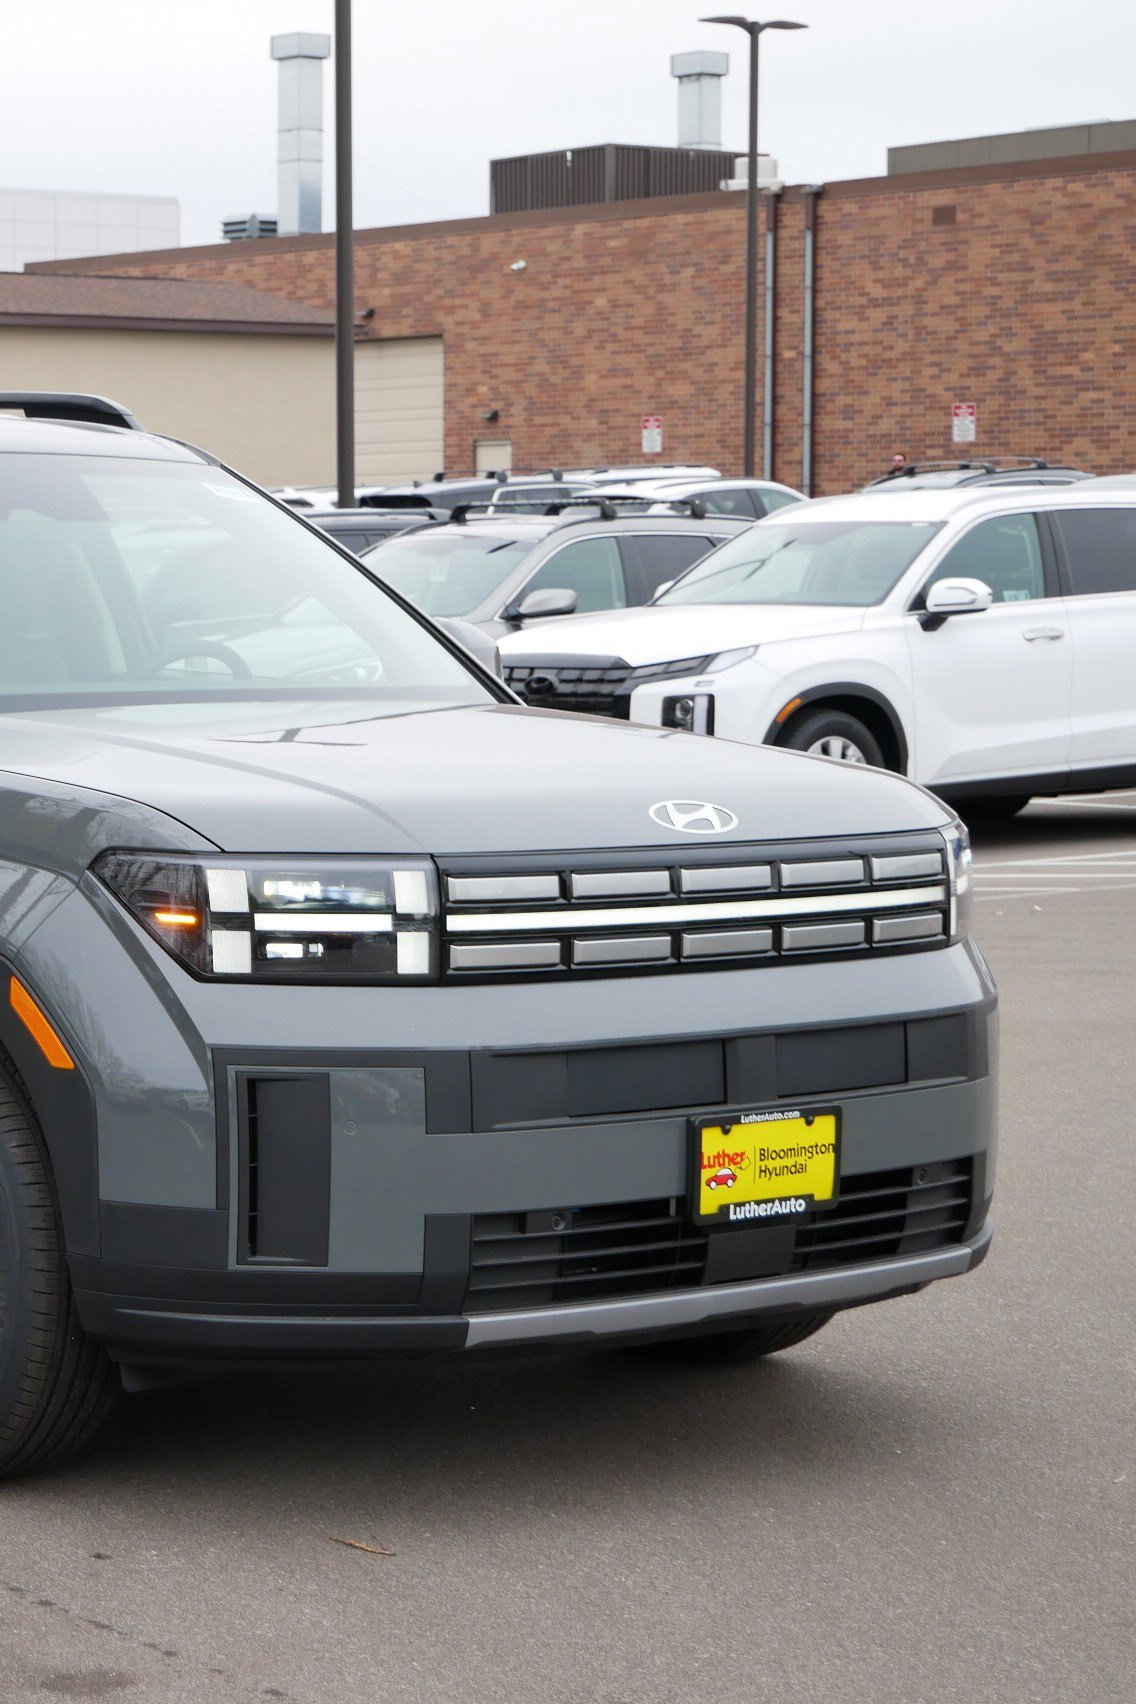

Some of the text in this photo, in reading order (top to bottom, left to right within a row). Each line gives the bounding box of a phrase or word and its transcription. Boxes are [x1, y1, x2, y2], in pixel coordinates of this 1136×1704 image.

[740, 1110, 801, 1124] LutherAuto.com
[700, 1149, 746, 1170] Luther
[759, 1142, 836, 1162] Bloomington
[759, 1159, 808, 1181] Hyundai
[729, 1198, 806, 1221] LutherAuto
